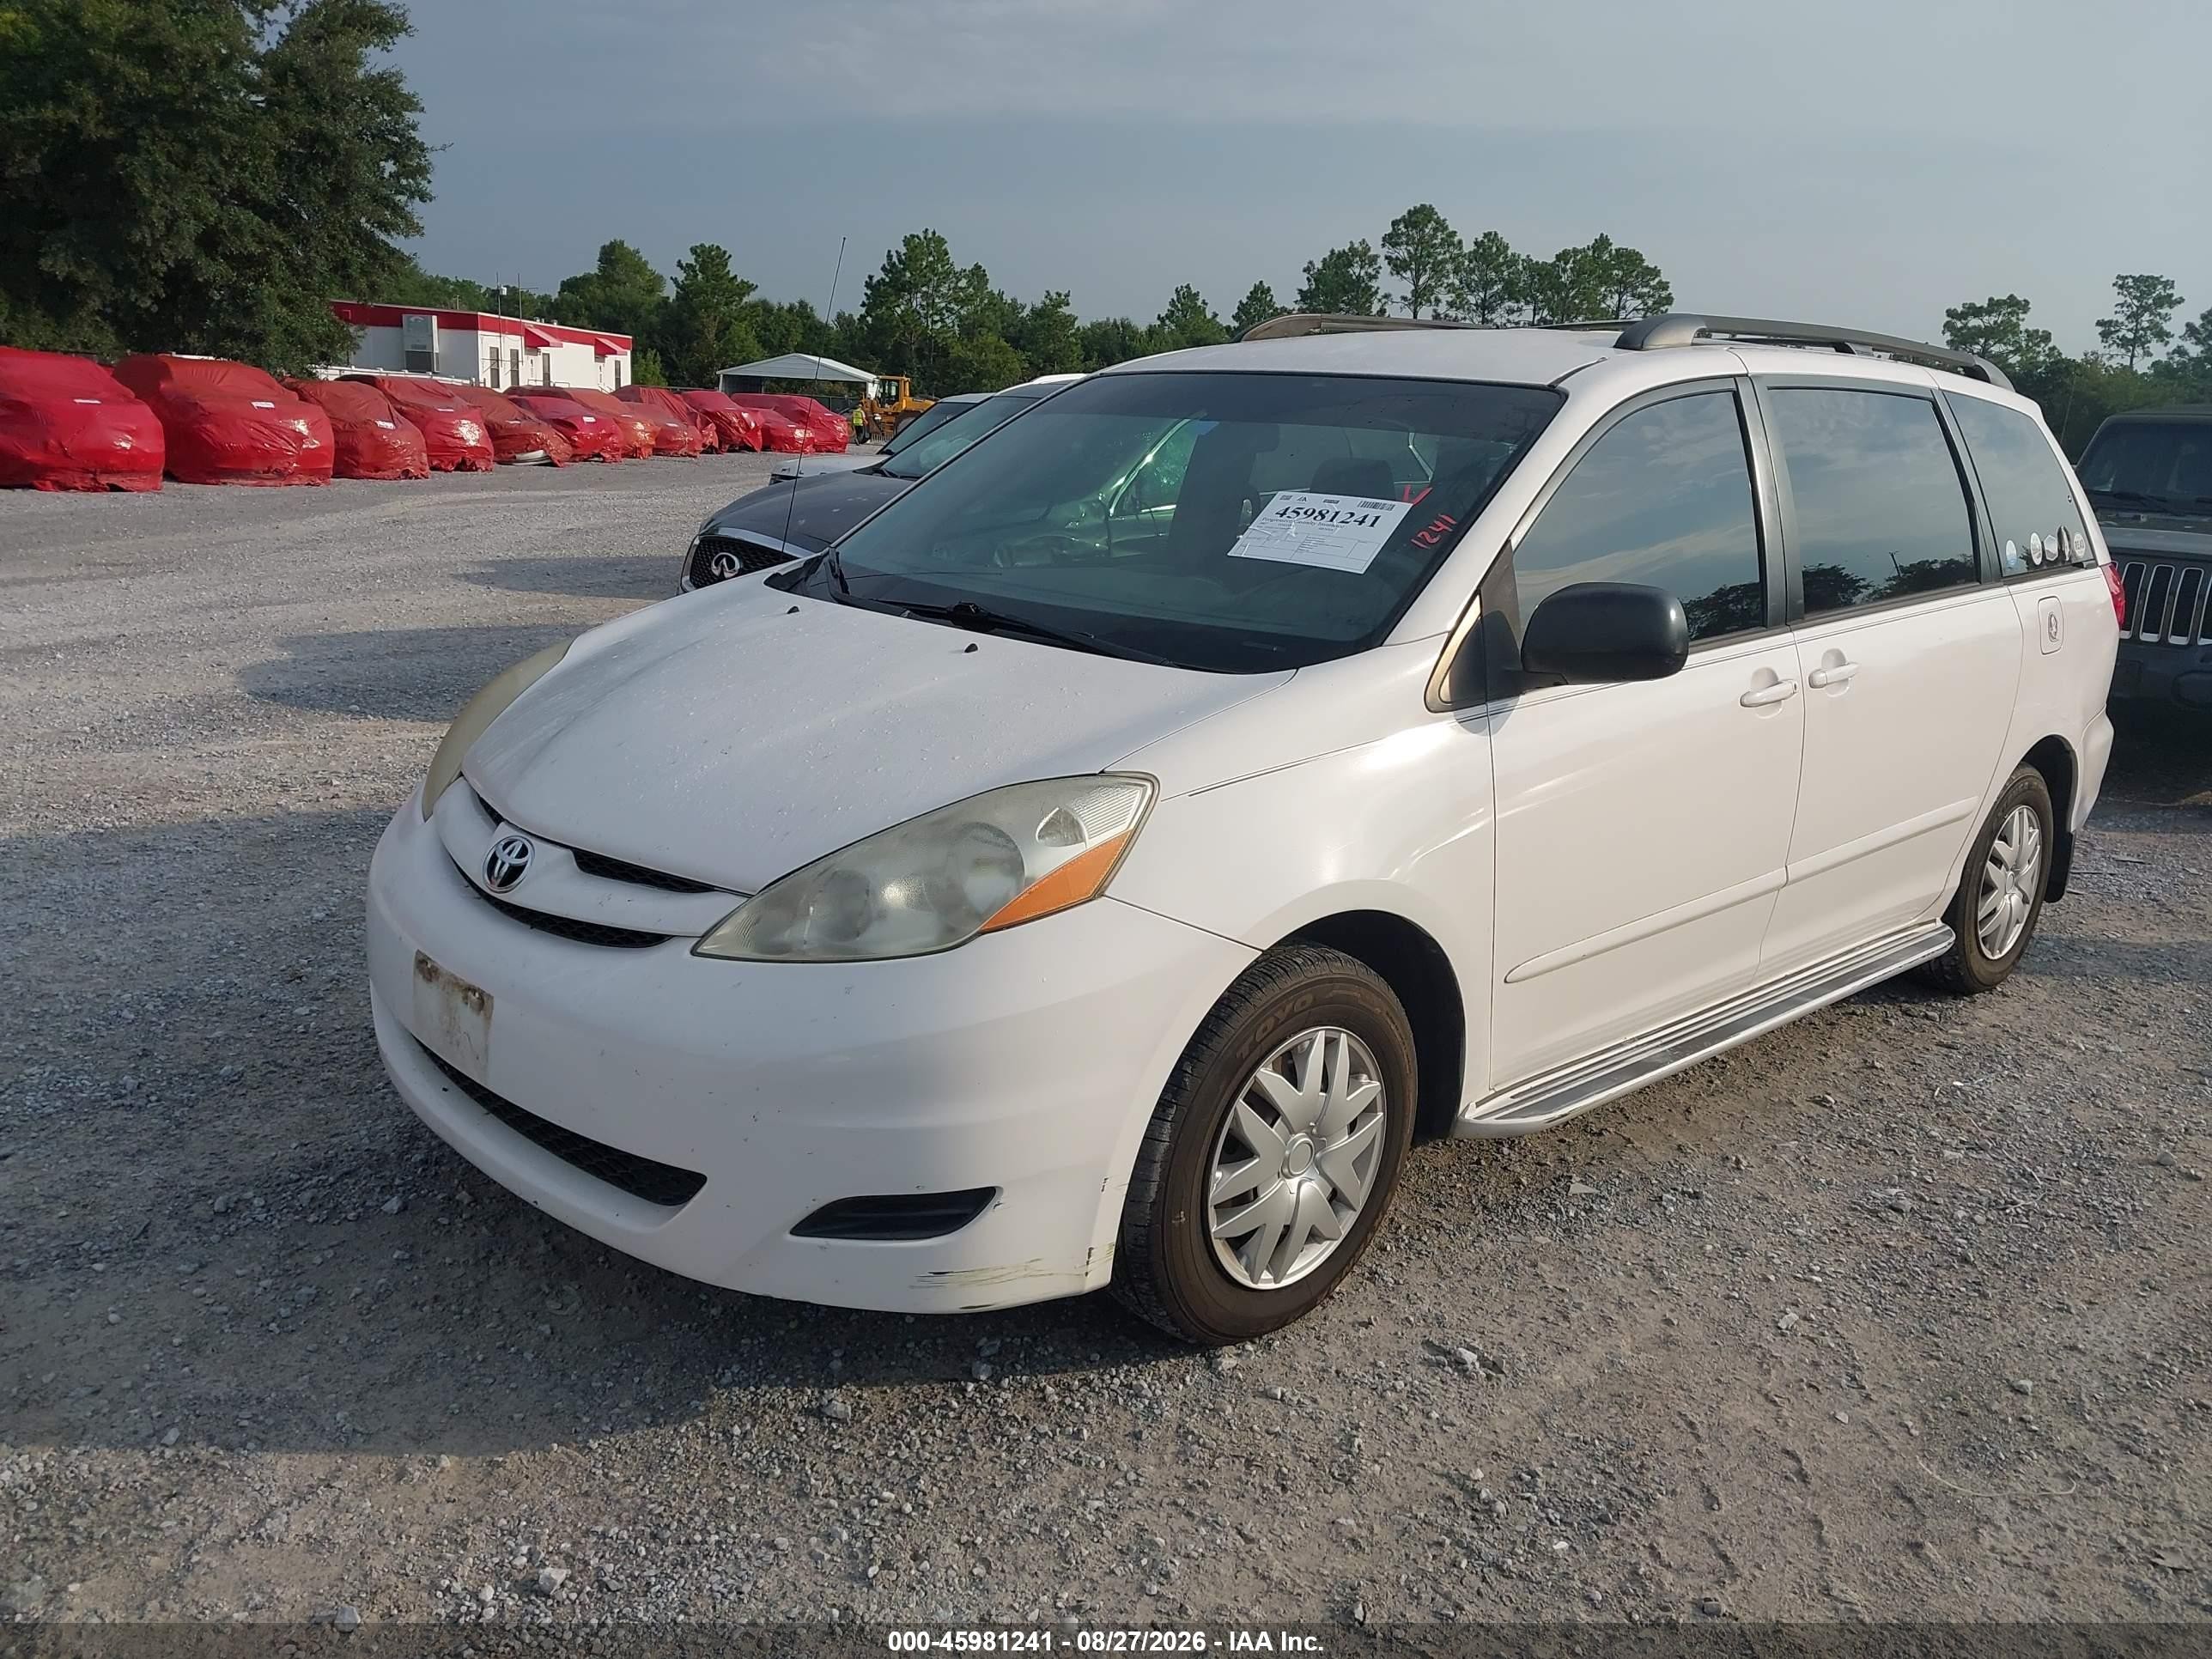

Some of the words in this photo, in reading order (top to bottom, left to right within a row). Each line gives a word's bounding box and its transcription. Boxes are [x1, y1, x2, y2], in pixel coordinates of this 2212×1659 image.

[1275, 506, 1382, 528] 45981241
[1410, 514, 1457, 550] 1241
[1237, 993, 1315, 1060] TOYO
